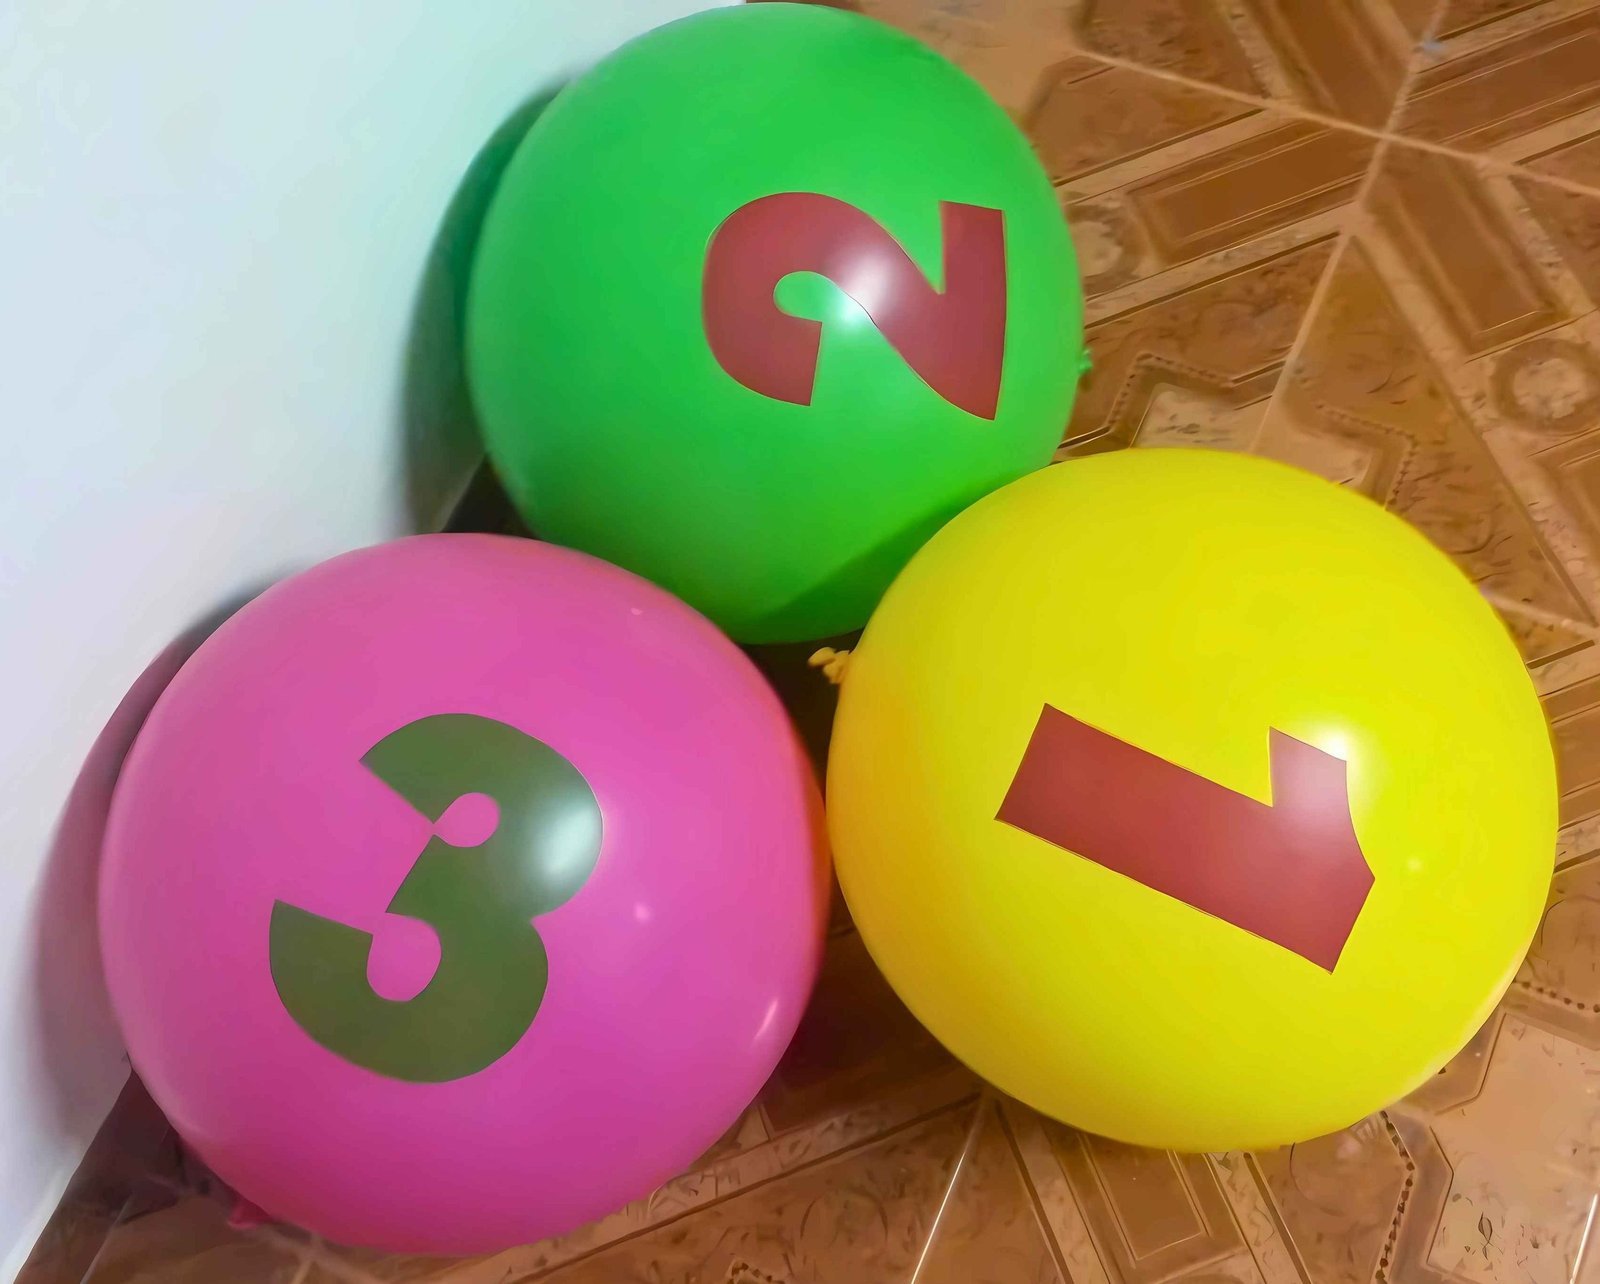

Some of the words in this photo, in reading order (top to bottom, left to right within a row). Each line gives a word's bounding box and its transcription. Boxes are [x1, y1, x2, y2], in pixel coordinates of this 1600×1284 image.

[702, 192, 1006, 420] 2
[269, 713, 603, 1083] 3
[995, 703, 1374, 973] 1
